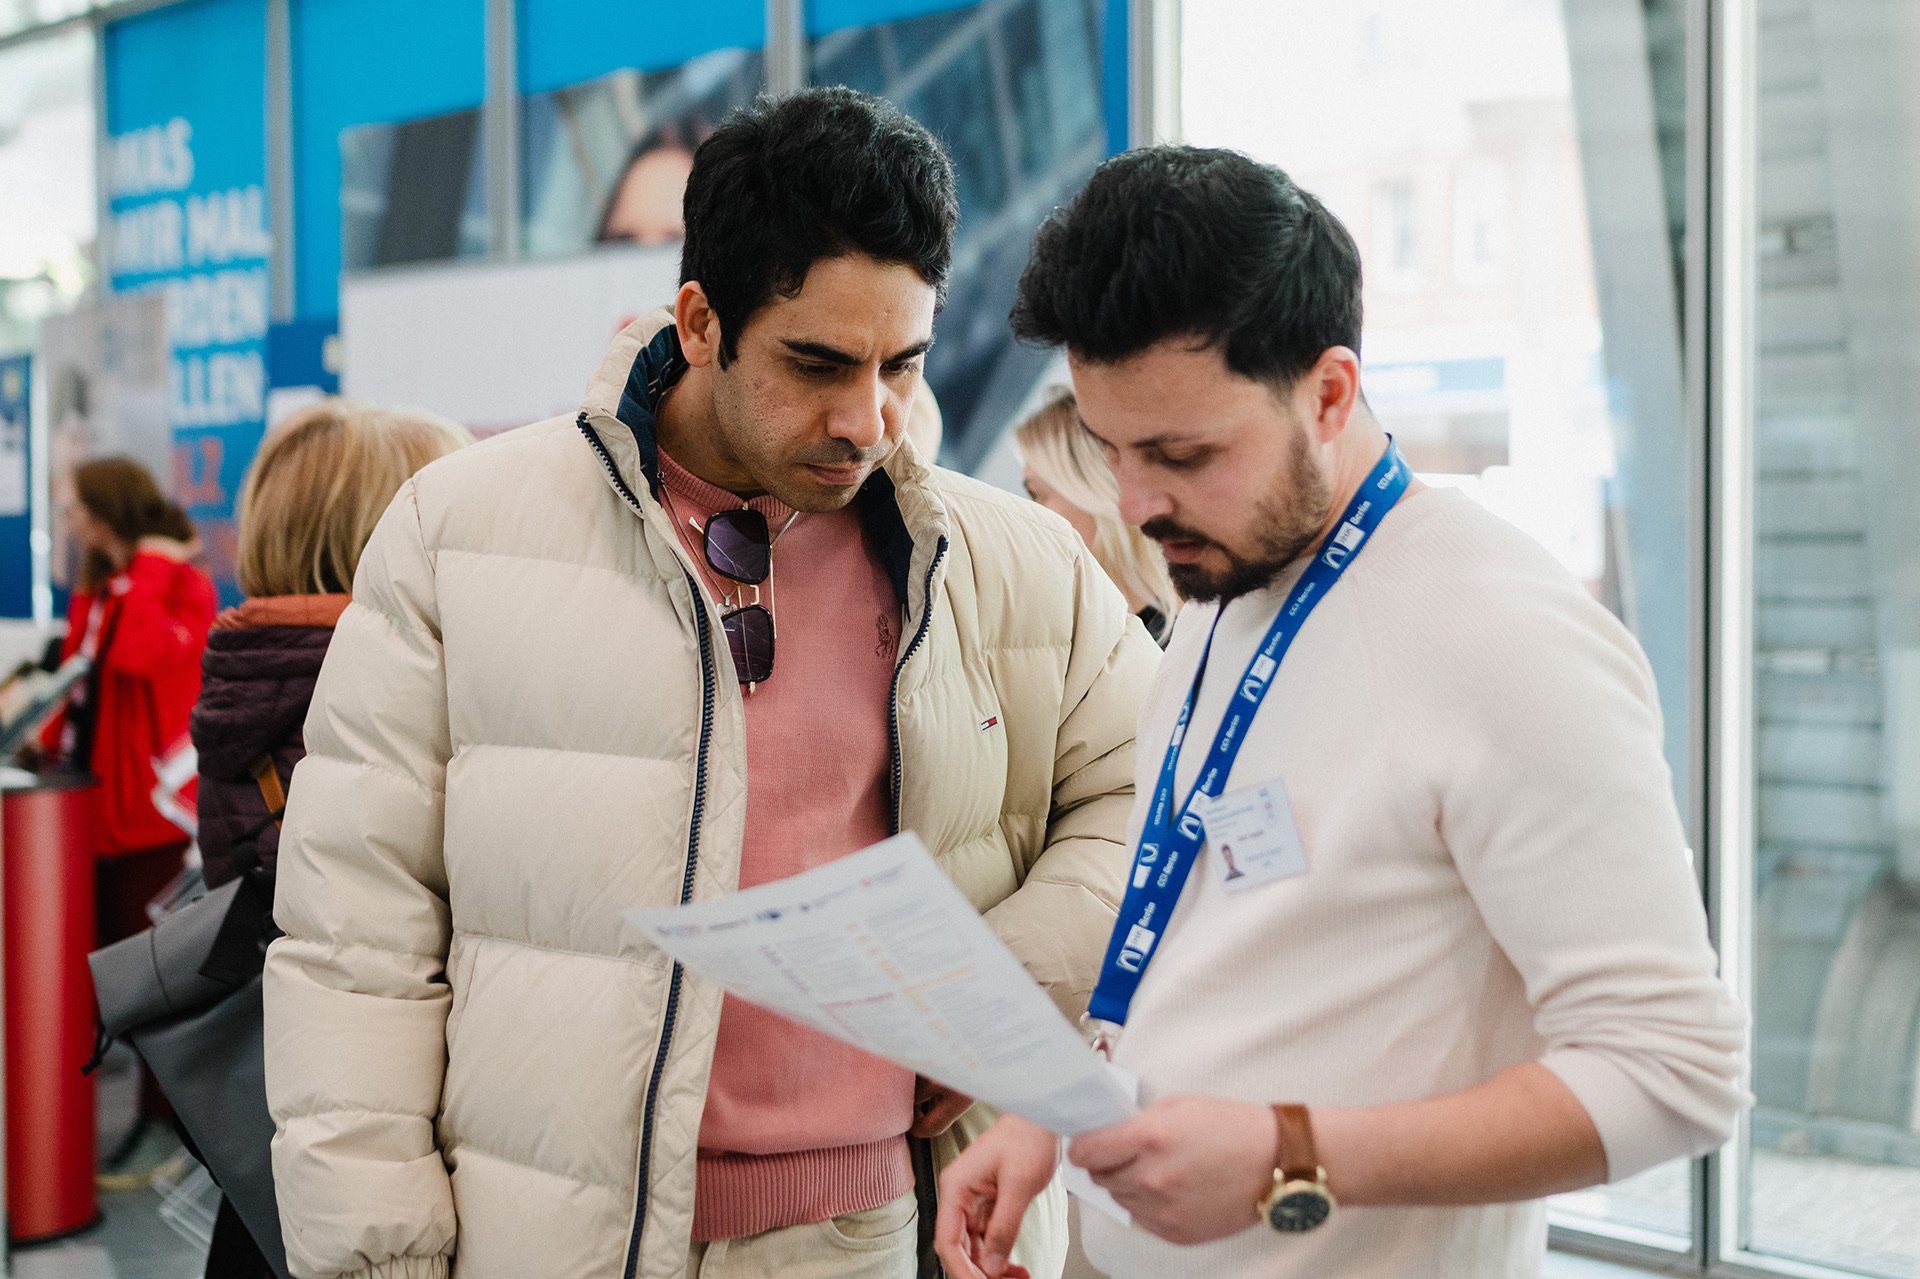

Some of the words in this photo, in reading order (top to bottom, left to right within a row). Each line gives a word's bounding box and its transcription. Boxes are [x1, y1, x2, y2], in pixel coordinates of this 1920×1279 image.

[186, 184, 271, 266] MAL
[163, 265, 269, 348] RDEN
[168, 350, 266, 427] LLEN
[1350, 500, 1371, 525] Berlin
[1138, 901, 1157, 928] Berlin
